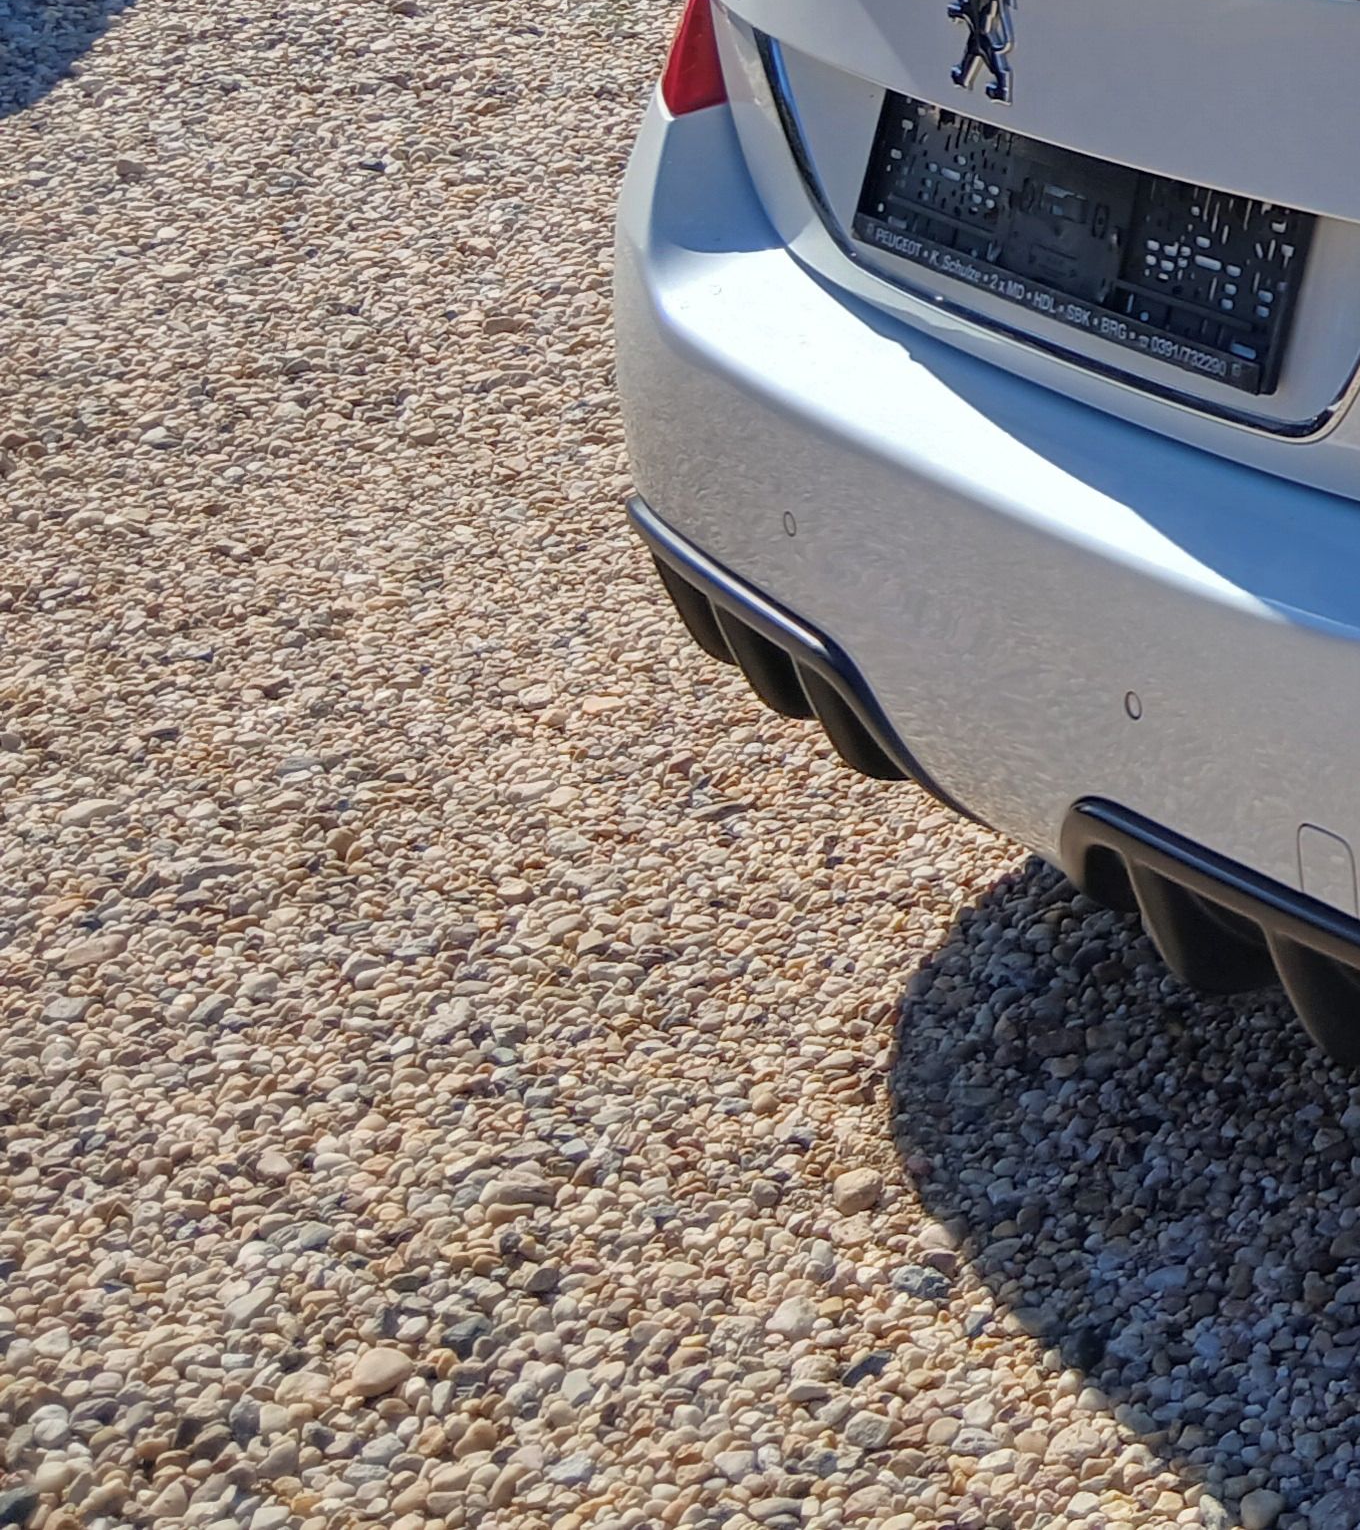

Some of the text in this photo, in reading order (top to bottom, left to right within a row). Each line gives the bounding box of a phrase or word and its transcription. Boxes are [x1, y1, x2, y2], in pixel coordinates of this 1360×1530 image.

[875, 227, 922, 258] PEUGEOT
[1032, 291, 1057, 314] HDL
[1065, 304, 1092, 327] SBK
[1100, 317, 1128, 340] BRG
